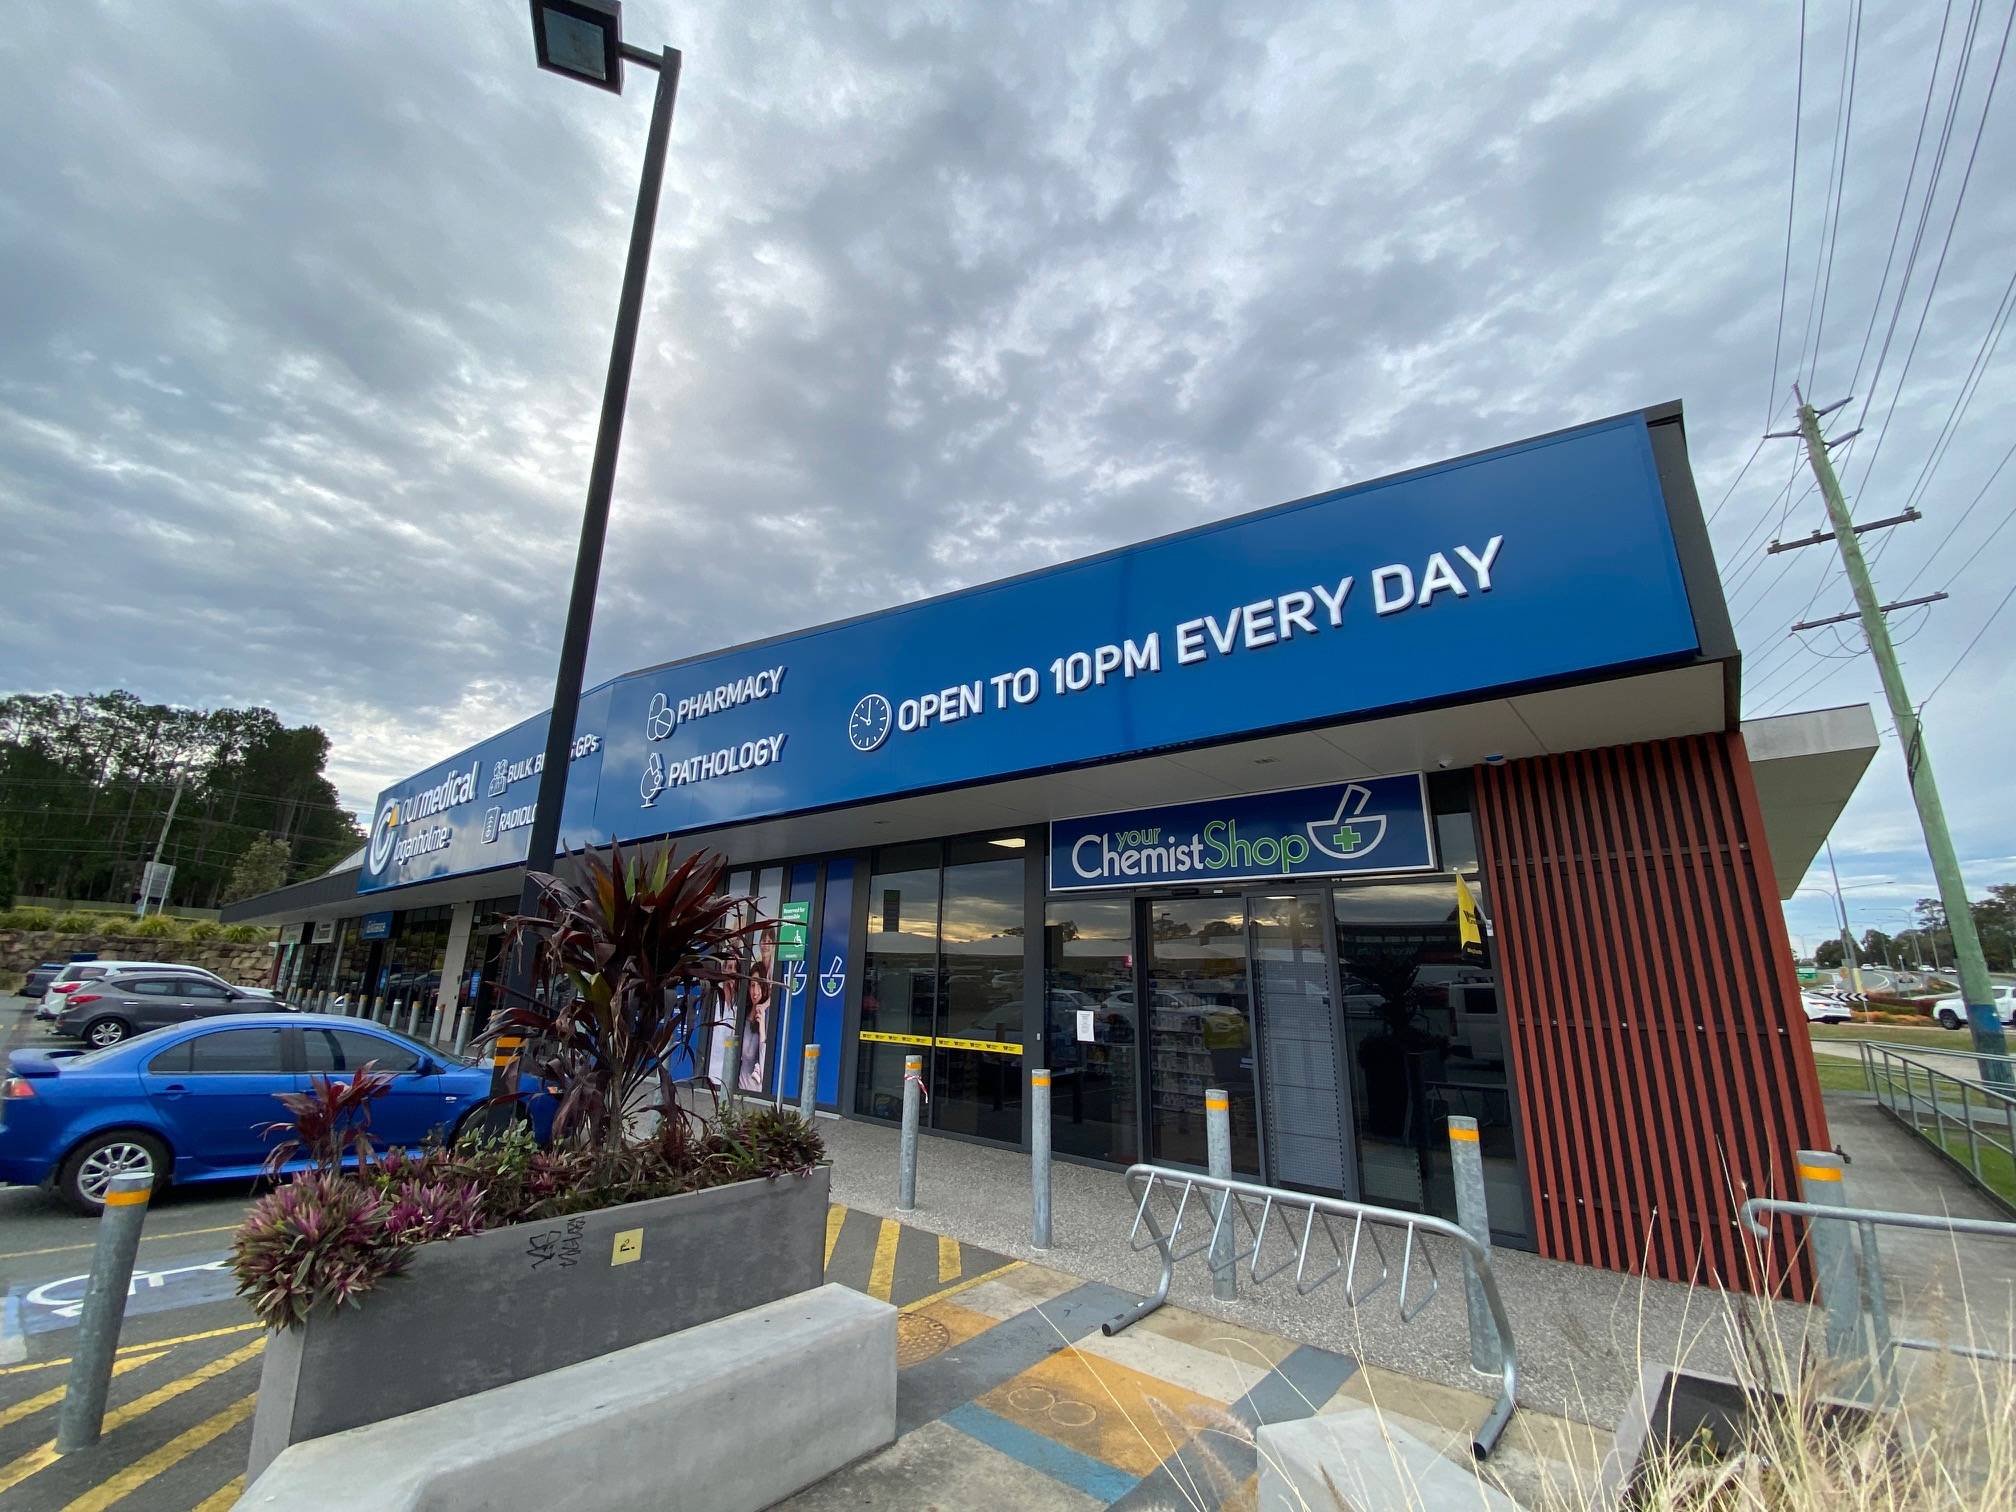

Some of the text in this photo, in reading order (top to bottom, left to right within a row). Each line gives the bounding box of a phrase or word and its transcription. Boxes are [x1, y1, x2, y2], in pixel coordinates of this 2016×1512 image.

[897, 536, 1504, 732] OPEN TO 10PM EVERY DAY
[677, 666, 785, 724] PHARMACY
[507, 757, 534, 783] BULK
[576, 734, 602, 757] GPs
[668, 733, 786, 787] PATHOLOGY
[499, 803, 538, 831] RADIOL
[1116, 828, 1161, 850] your
[394, 824, 450, 865] loganholme
